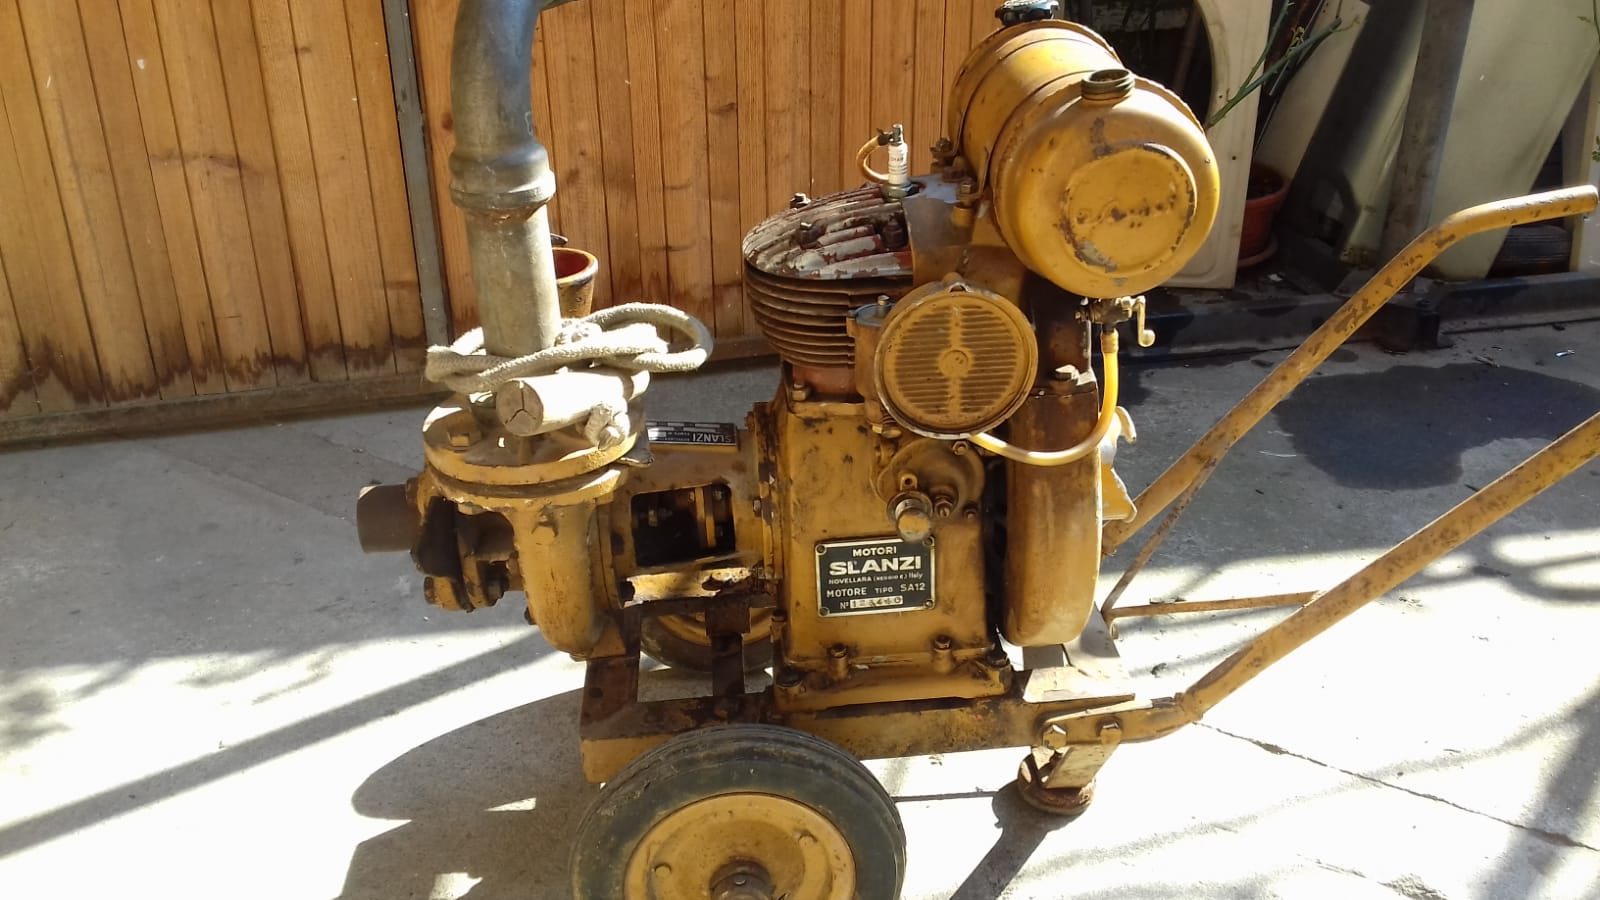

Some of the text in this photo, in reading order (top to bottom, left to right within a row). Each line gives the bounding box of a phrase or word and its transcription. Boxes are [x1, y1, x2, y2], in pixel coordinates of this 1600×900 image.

[692, 433, 732, 442] SLANZI
[853, 546, 896, 557] MOTORI
[829, 556, 921, 575] SLANZI
[828, 577, 872, 585] NOVELLARA
[826, 587, 868, 598] MOTORE
[900, 583, 926, 592] SA12
